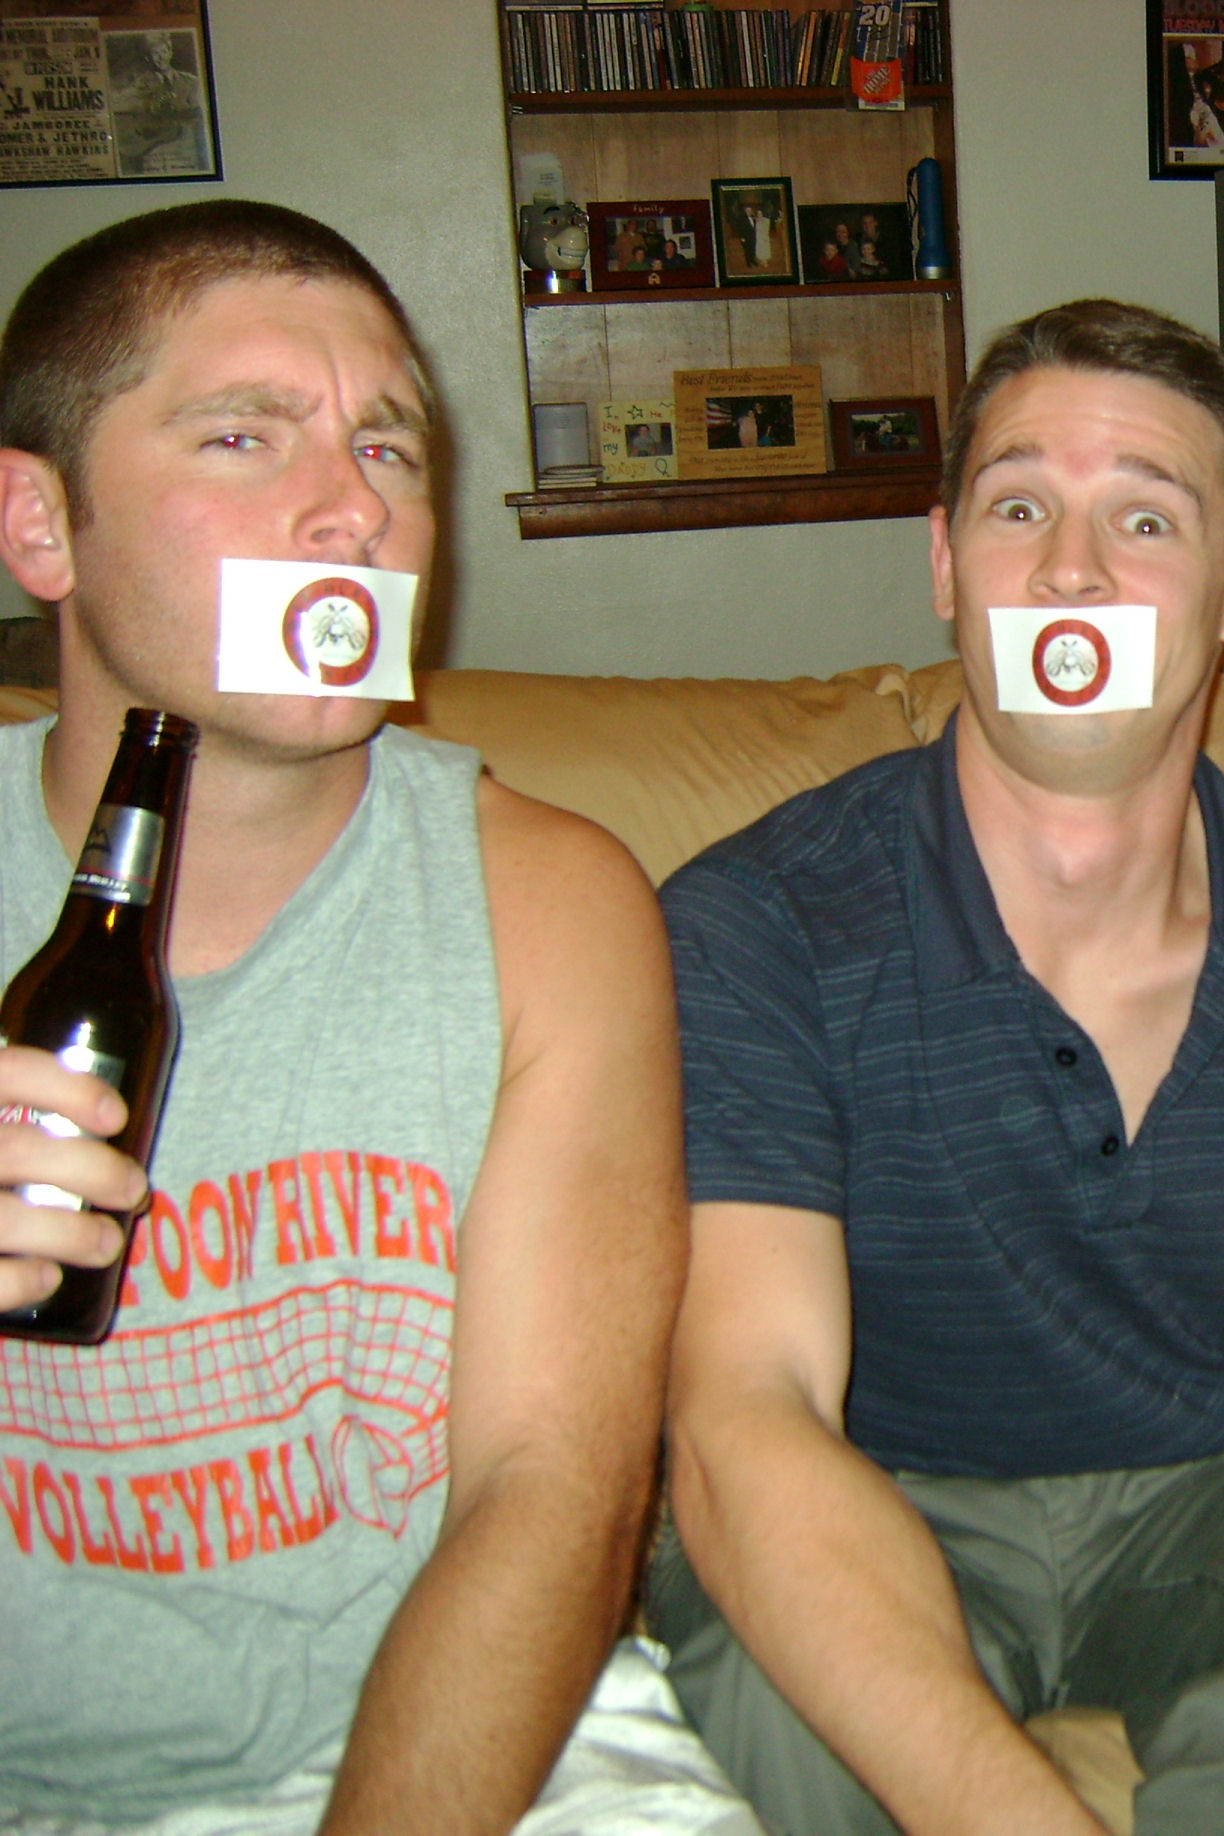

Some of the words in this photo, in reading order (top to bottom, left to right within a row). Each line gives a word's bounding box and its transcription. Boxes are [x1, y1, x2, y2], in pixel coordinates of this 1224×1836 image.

[859, 5, 890, 26] 20
[44, 76, 89, 89] HANK
[32, 89, 105, 111] WILLIAMS
[13, 120, 91, 130] JAMBOREE
[53, 131, 108, 143] JETHRO
[633, 203, 665, 215] family
[680, 374, 705, 386] Best
[708, 371, 753, 385] Friends
[268, 1149, 459, 1275] RIVER
[0, 1432, 341, 1575] VOLLEYBALL
